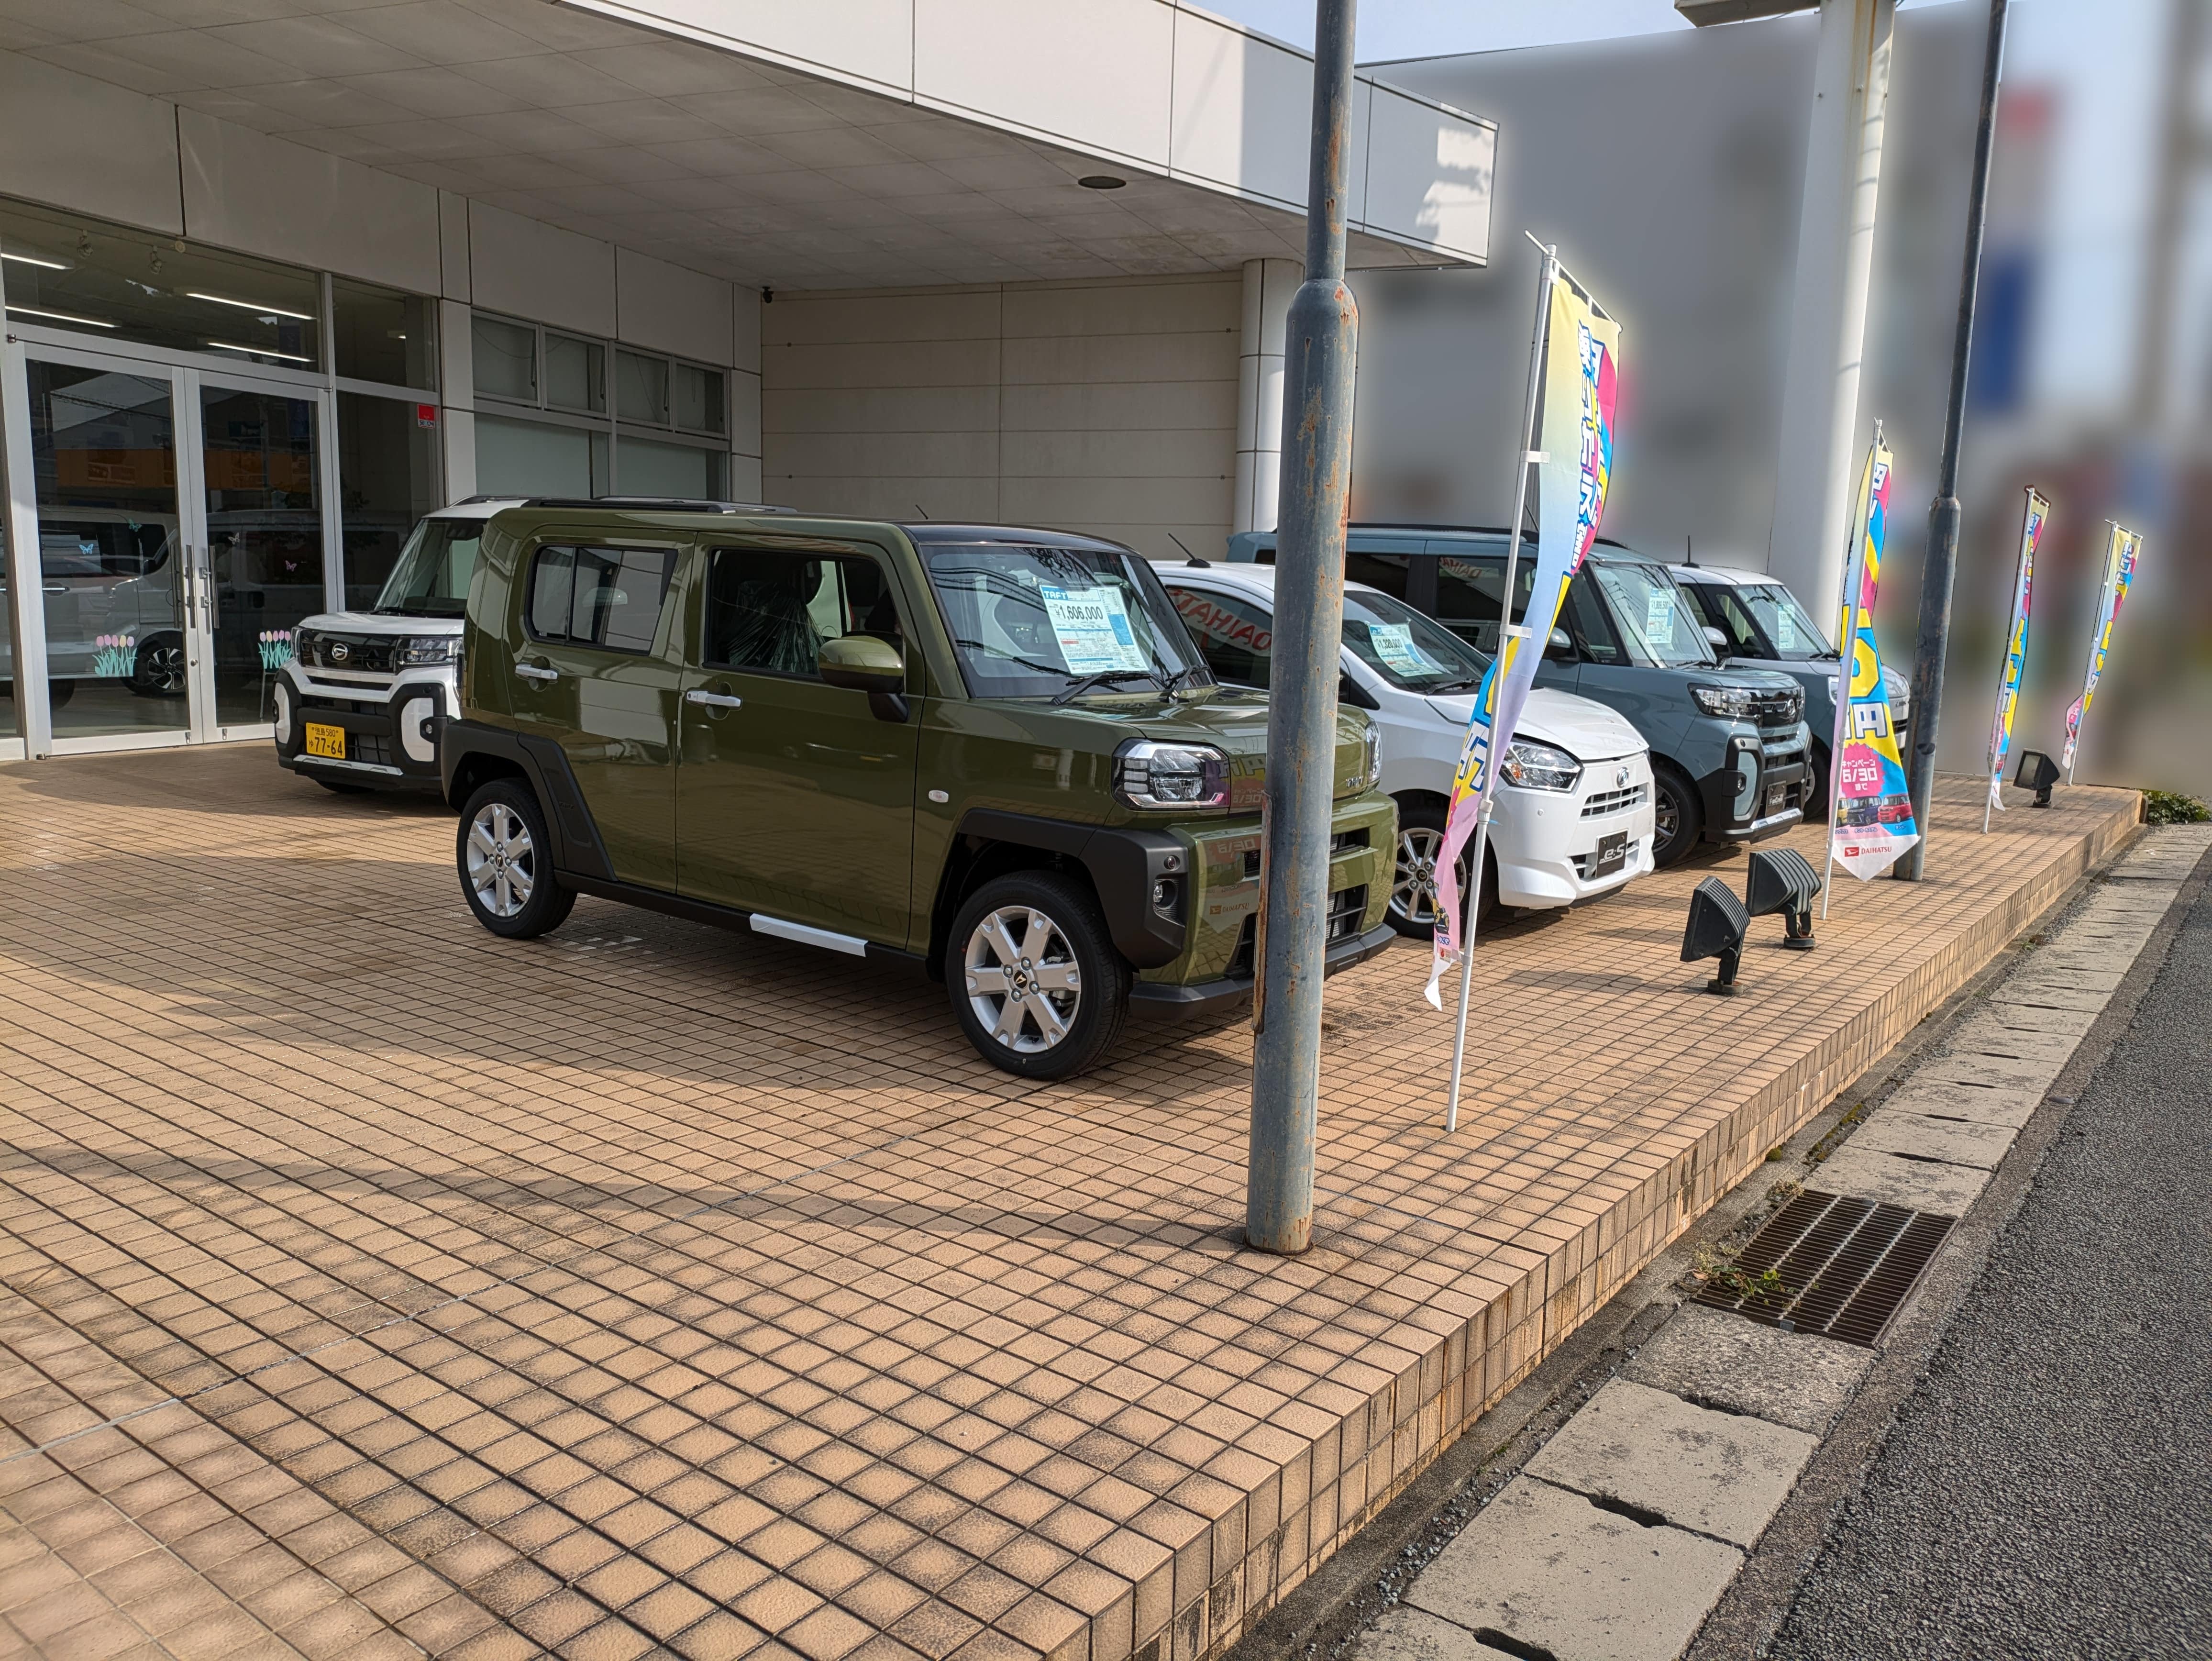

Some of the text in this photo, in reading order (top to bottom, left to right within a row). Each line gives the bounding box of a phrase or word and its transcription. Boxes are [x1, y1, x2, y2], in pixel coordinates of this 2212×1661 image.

[1043, 591, 1066, 599] TAFT
[1055, 605, 1103, 621] ¥1,606,000
[326, 728, 336, 737] 580
[314, 736, 343, 756] 77-64
[1842, 767, 1878, 783] 6/30
[1861, 846, 1892, 854] DAIHATSU
